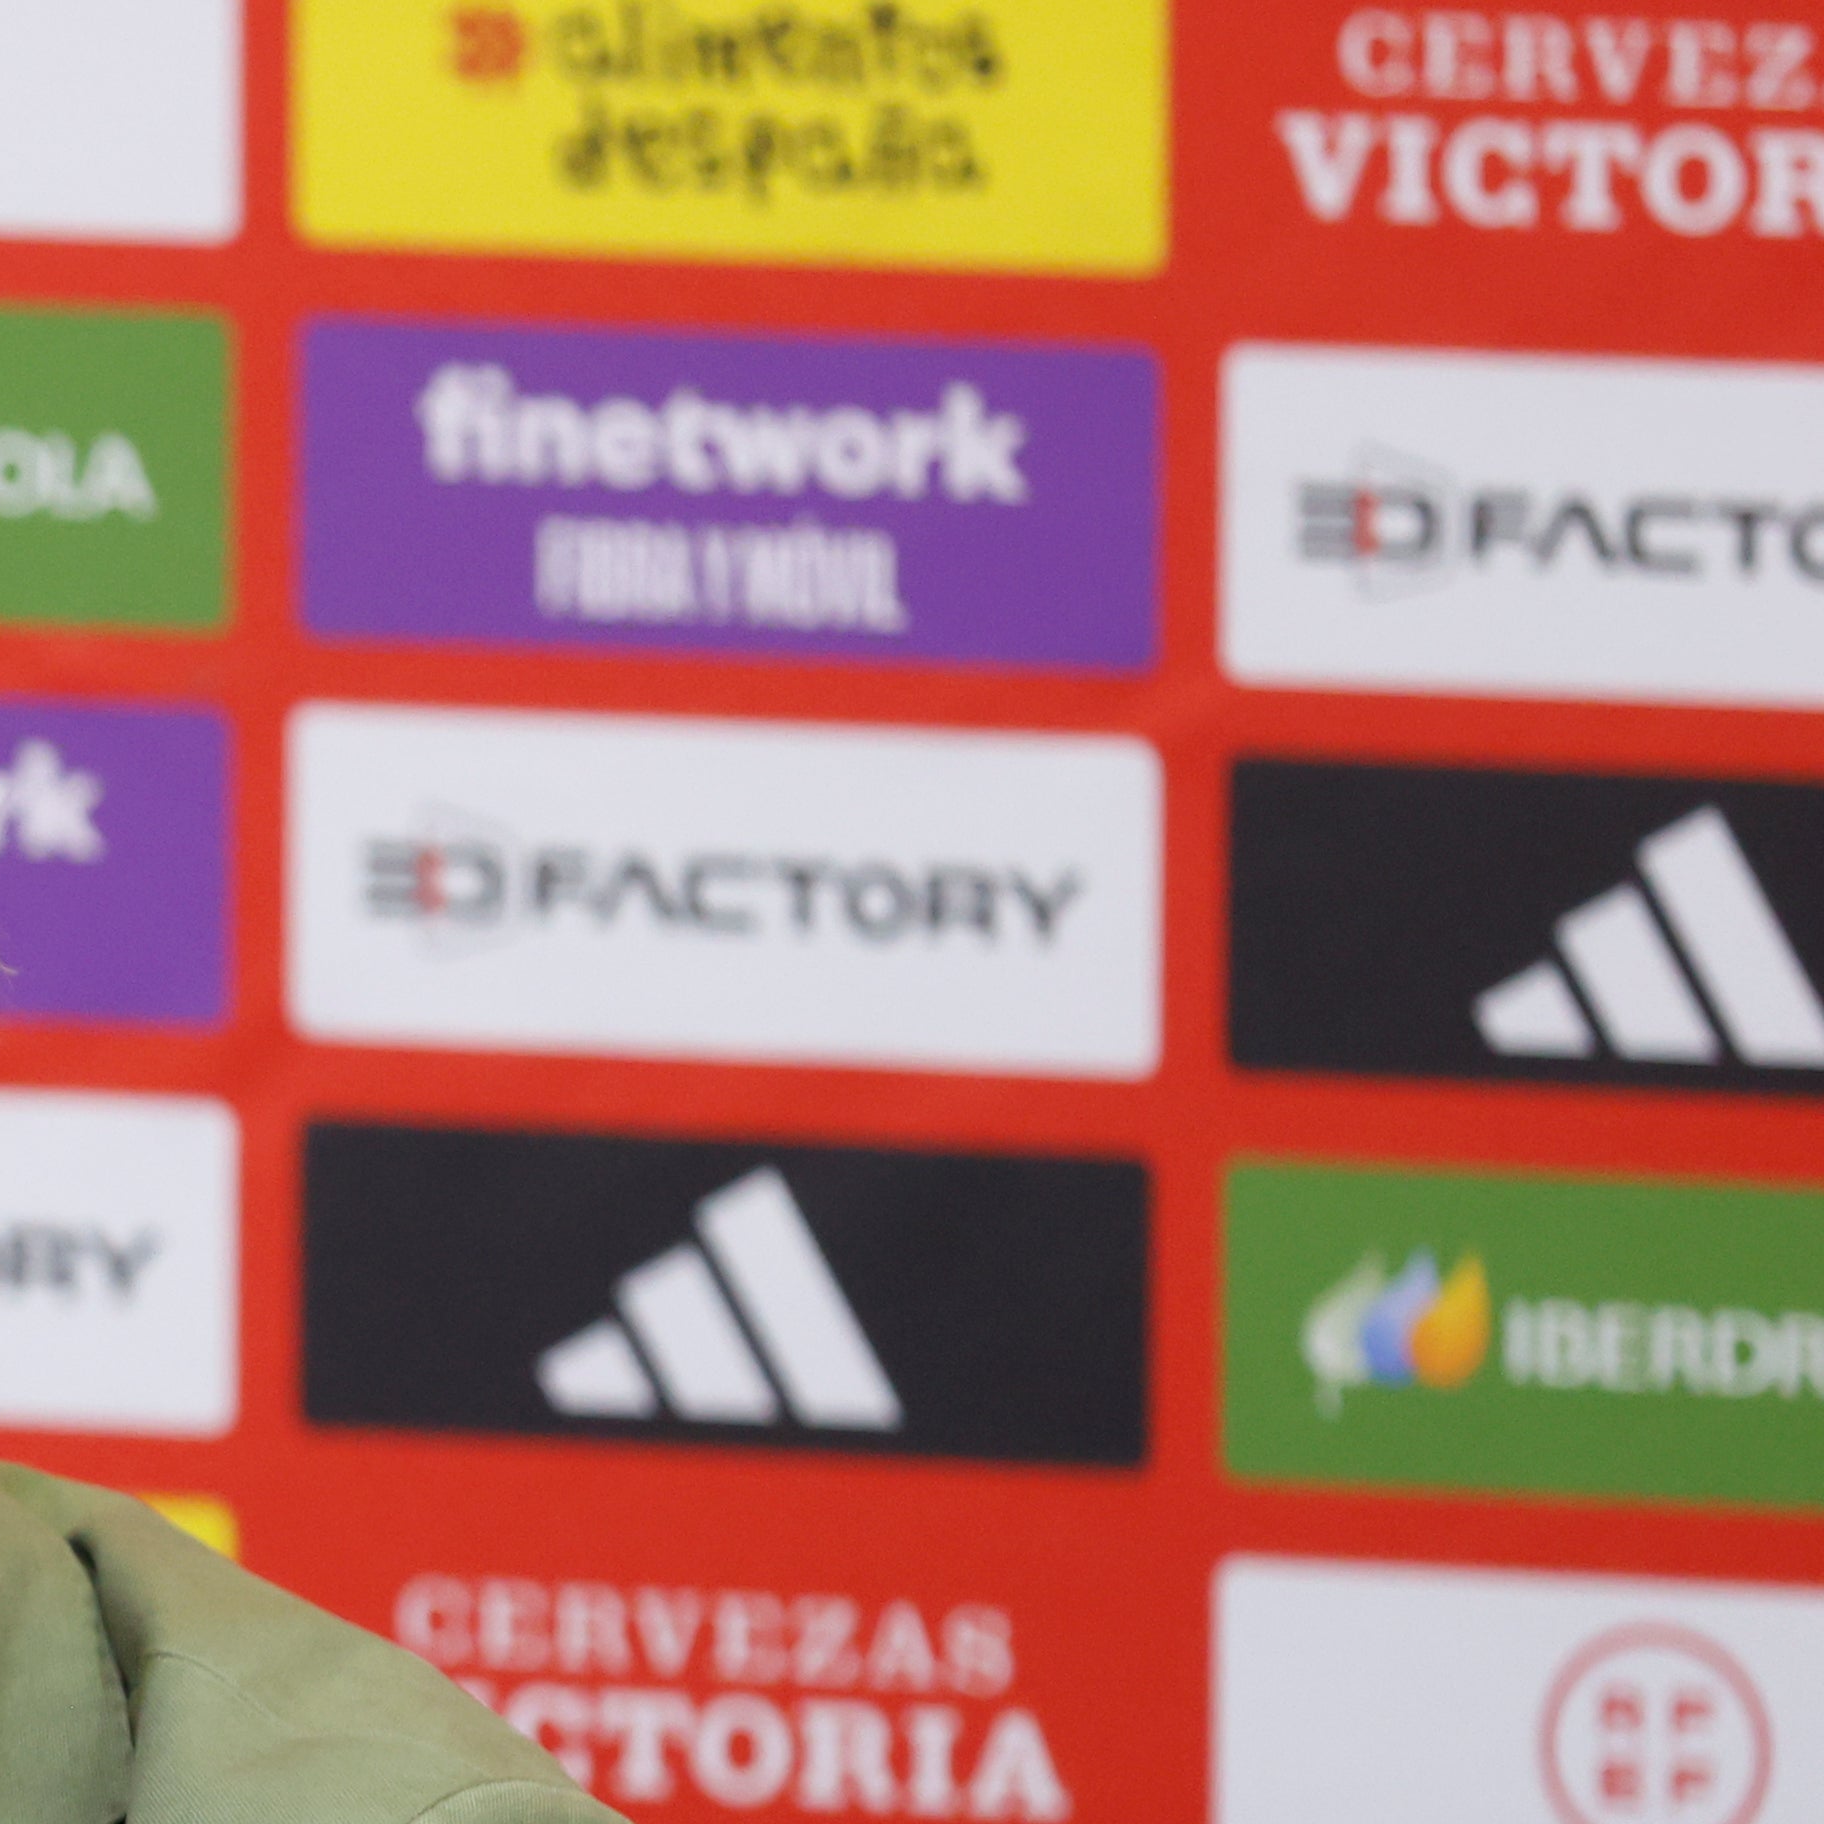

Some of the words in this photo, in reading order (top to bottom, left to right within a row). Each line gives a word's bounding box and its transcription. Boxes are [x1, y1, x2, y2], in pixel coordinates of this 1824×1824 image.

[415, 363, 1027, 503] finetwork
[532, 847, 1084, 946] FACTORY
[392, 1575, 1016, 1698] CERVEZAS
[460, 1678, 1070, 1824] CTORIA
